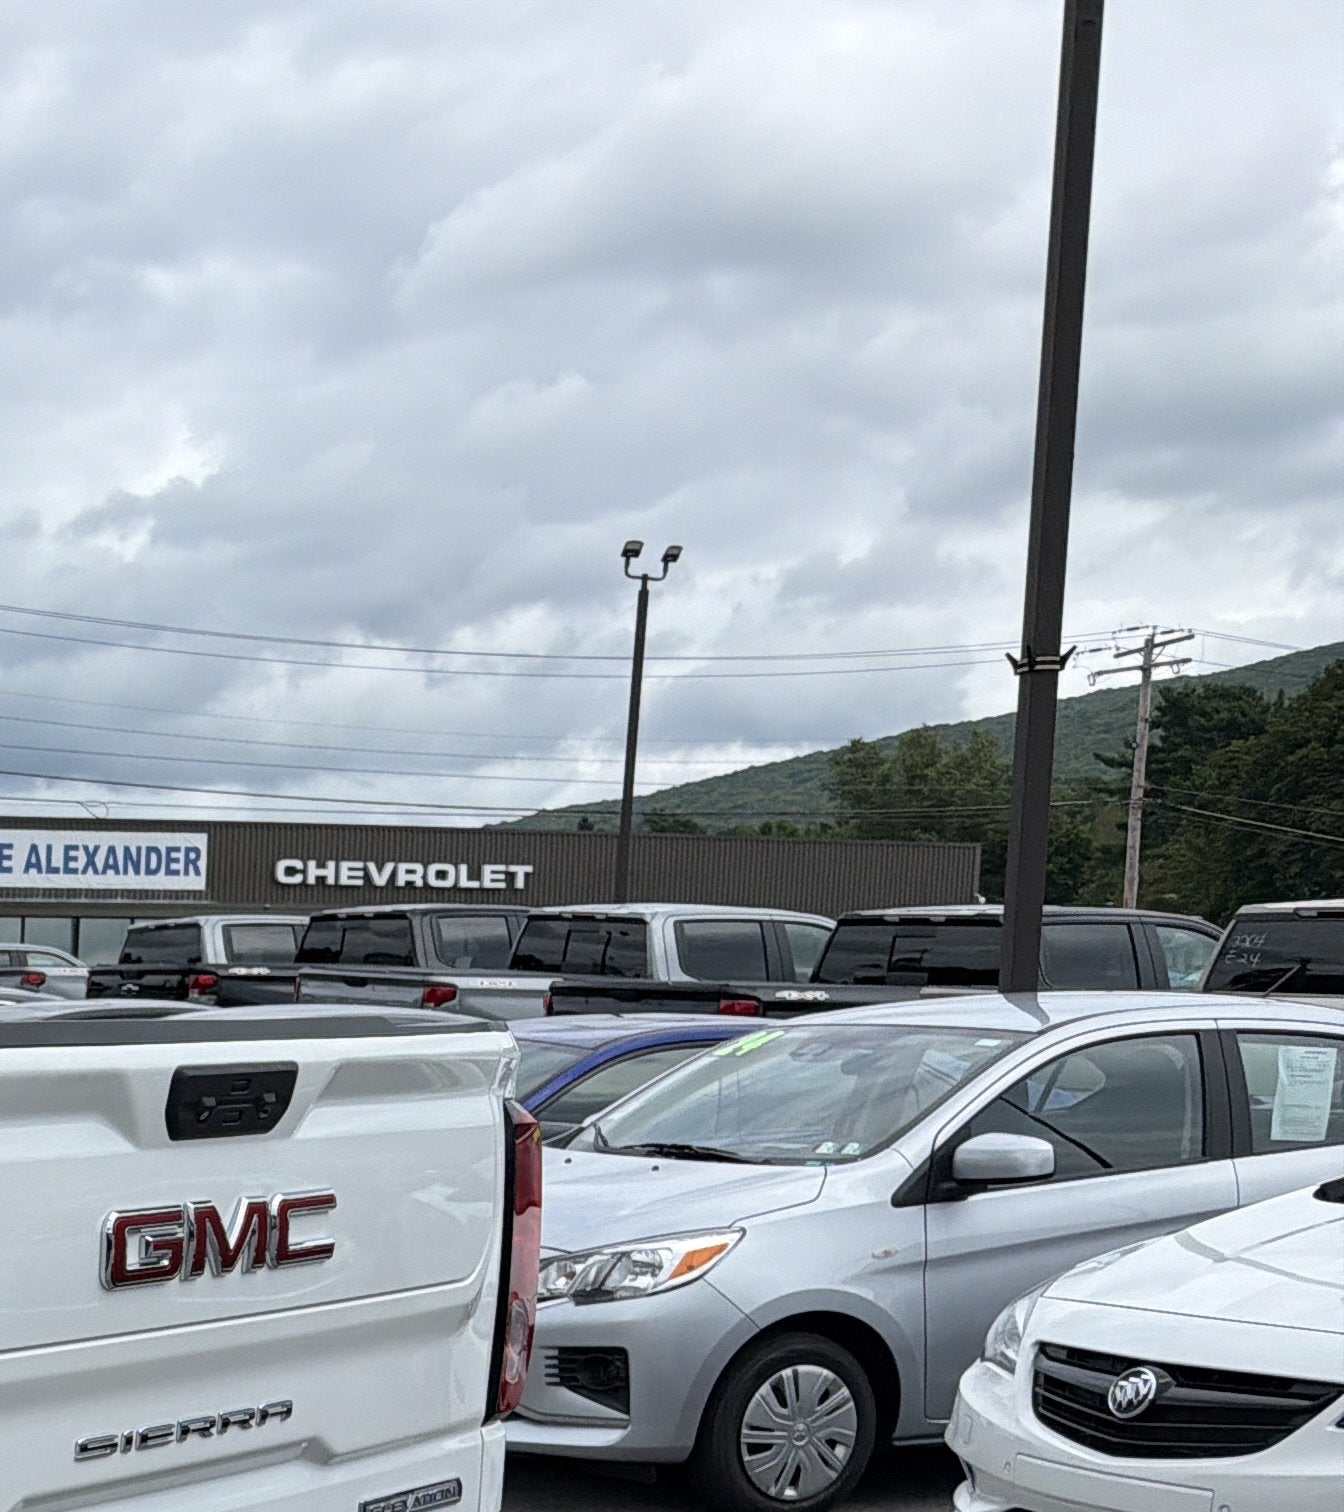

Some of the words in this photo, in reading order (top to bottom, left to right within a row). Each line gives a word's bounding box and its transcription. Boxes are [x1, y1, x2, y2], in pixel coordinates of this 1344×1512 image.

[22, 843, 202, 877] ALEXANDER
[275, 858, 534, 890] CHEVROLET
[99, 1188, 338, 1291] GMC
[74, 1400, 293, 1462] SIERRA
